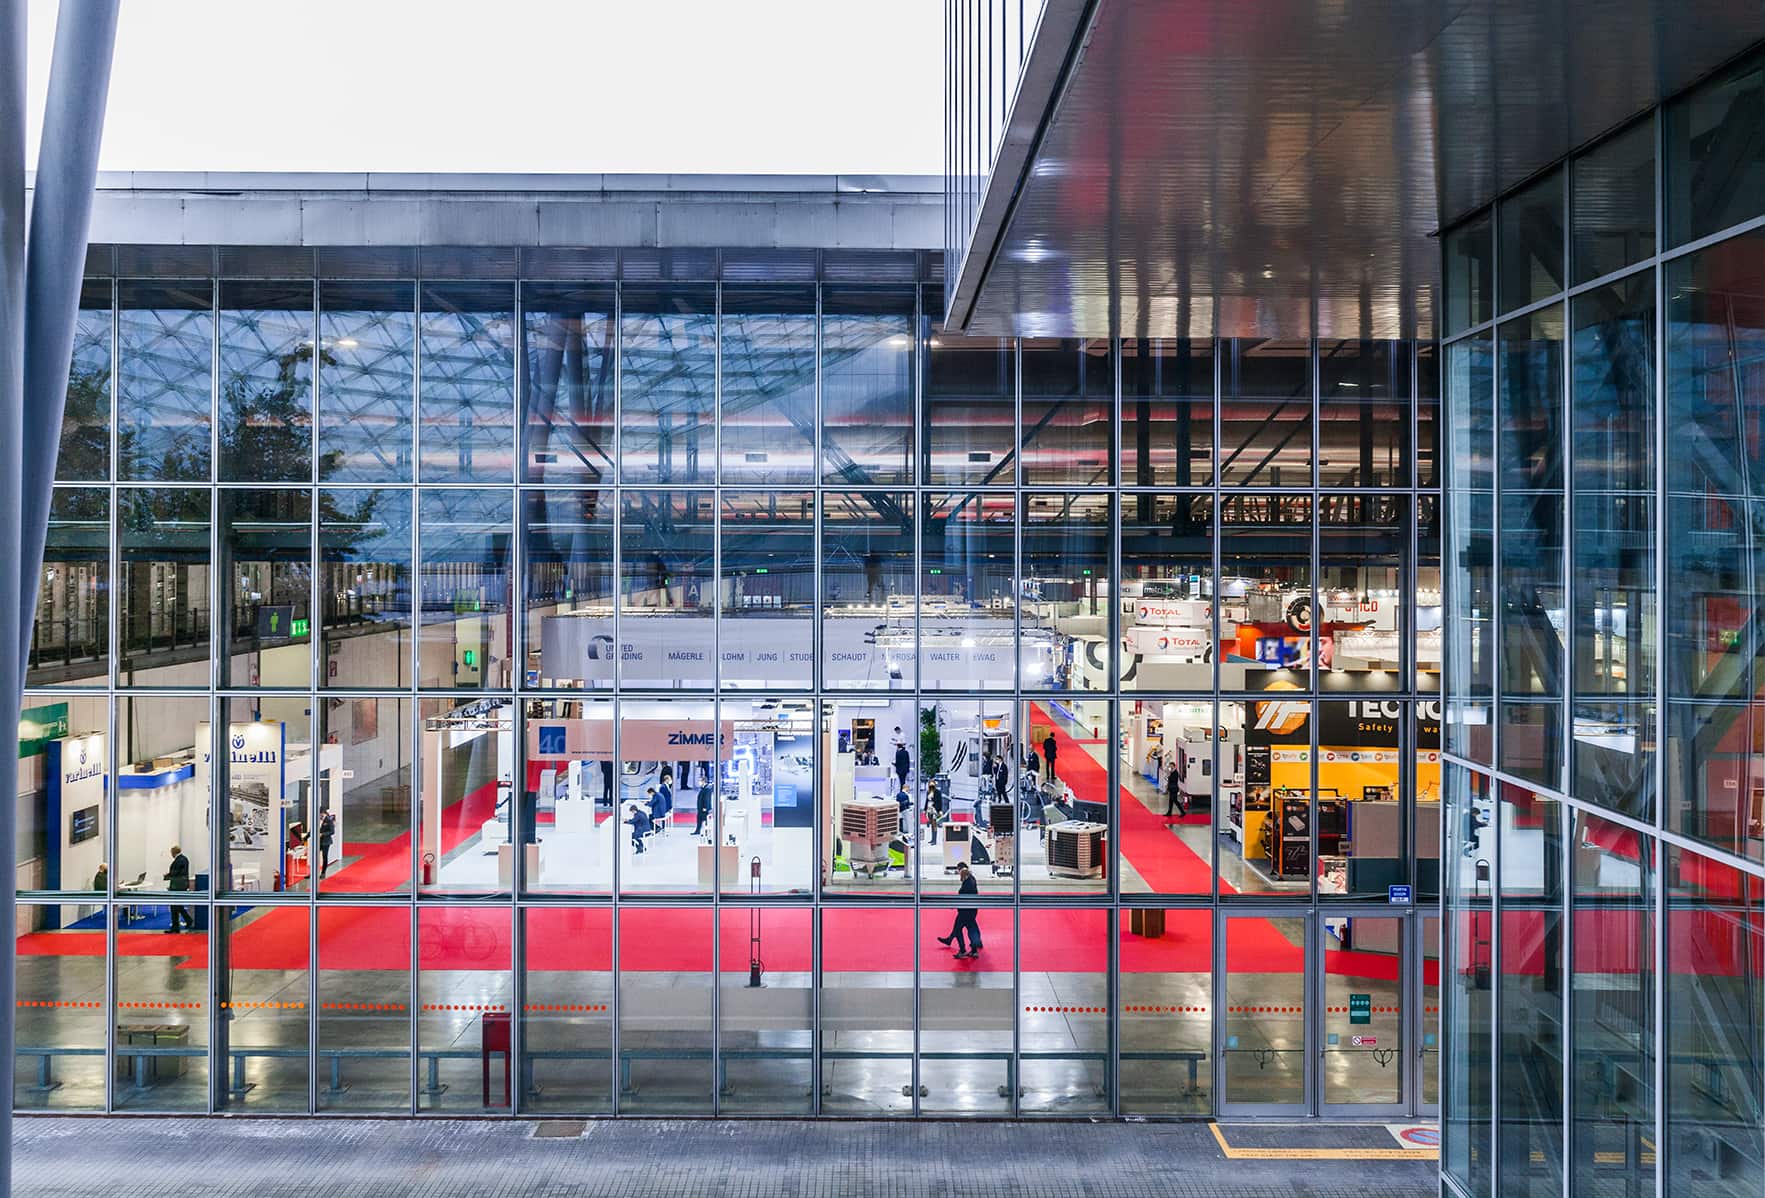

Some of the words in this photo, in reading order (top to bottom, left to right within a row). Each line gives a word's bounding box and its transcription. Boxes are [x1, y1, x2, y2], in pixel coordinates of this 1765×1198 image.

[1150, 607, 1182, 616] TOTAL
[1172, 637, 1200, 646] TOTAL
[721, 652, 745, 661] LOHM
[757, 652, 778, 661] JUNG
[831, 652, 867, 661] SCHAUDT
[930, 653, 960, 661] WALTER
[1358, 723, 1393, 734] Safety
